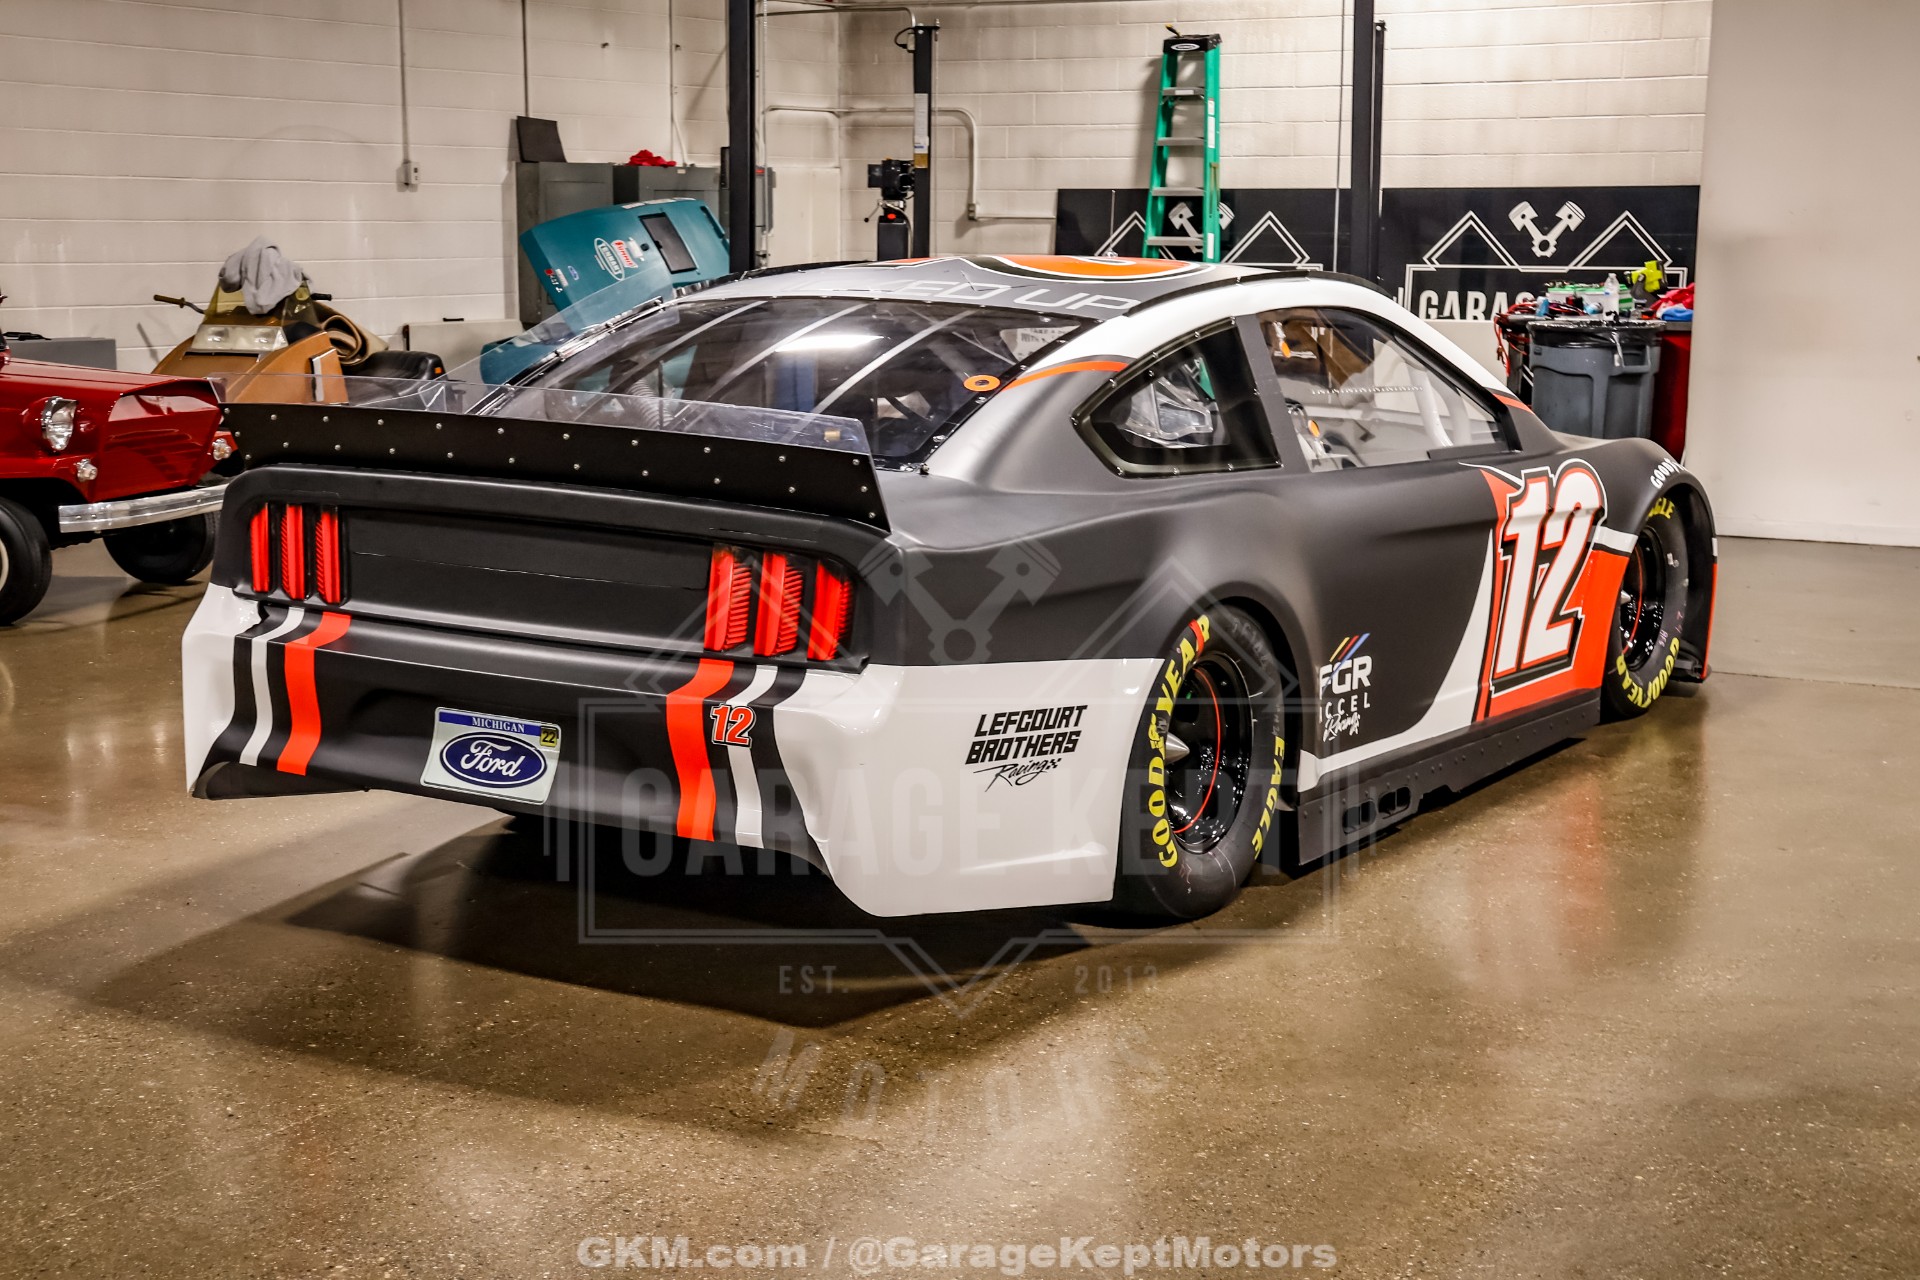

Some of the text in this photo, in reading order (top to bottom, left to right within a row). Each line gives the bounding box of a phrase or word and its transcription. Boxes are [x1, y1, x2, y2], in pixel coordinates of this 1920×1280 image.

[1014, 288, 1141, 310] UP
[1491, 459, 1607, 697] 12
[472, 716, 526, 734] MICHIGAN
[541, 730, 556, 744] 22
[710, 703, 757, 748] 12
[974, 704, 1088, 738] LEFCOURT
[460, 739, 526, 777] Ford
[965, 730, 1082, 765] BROTHERS
[1148, 614, 1210, 868] GOODYEAR
[973, 758, 1050, 793] Racing
[1251, 735, 1286, 860] EAGLE
